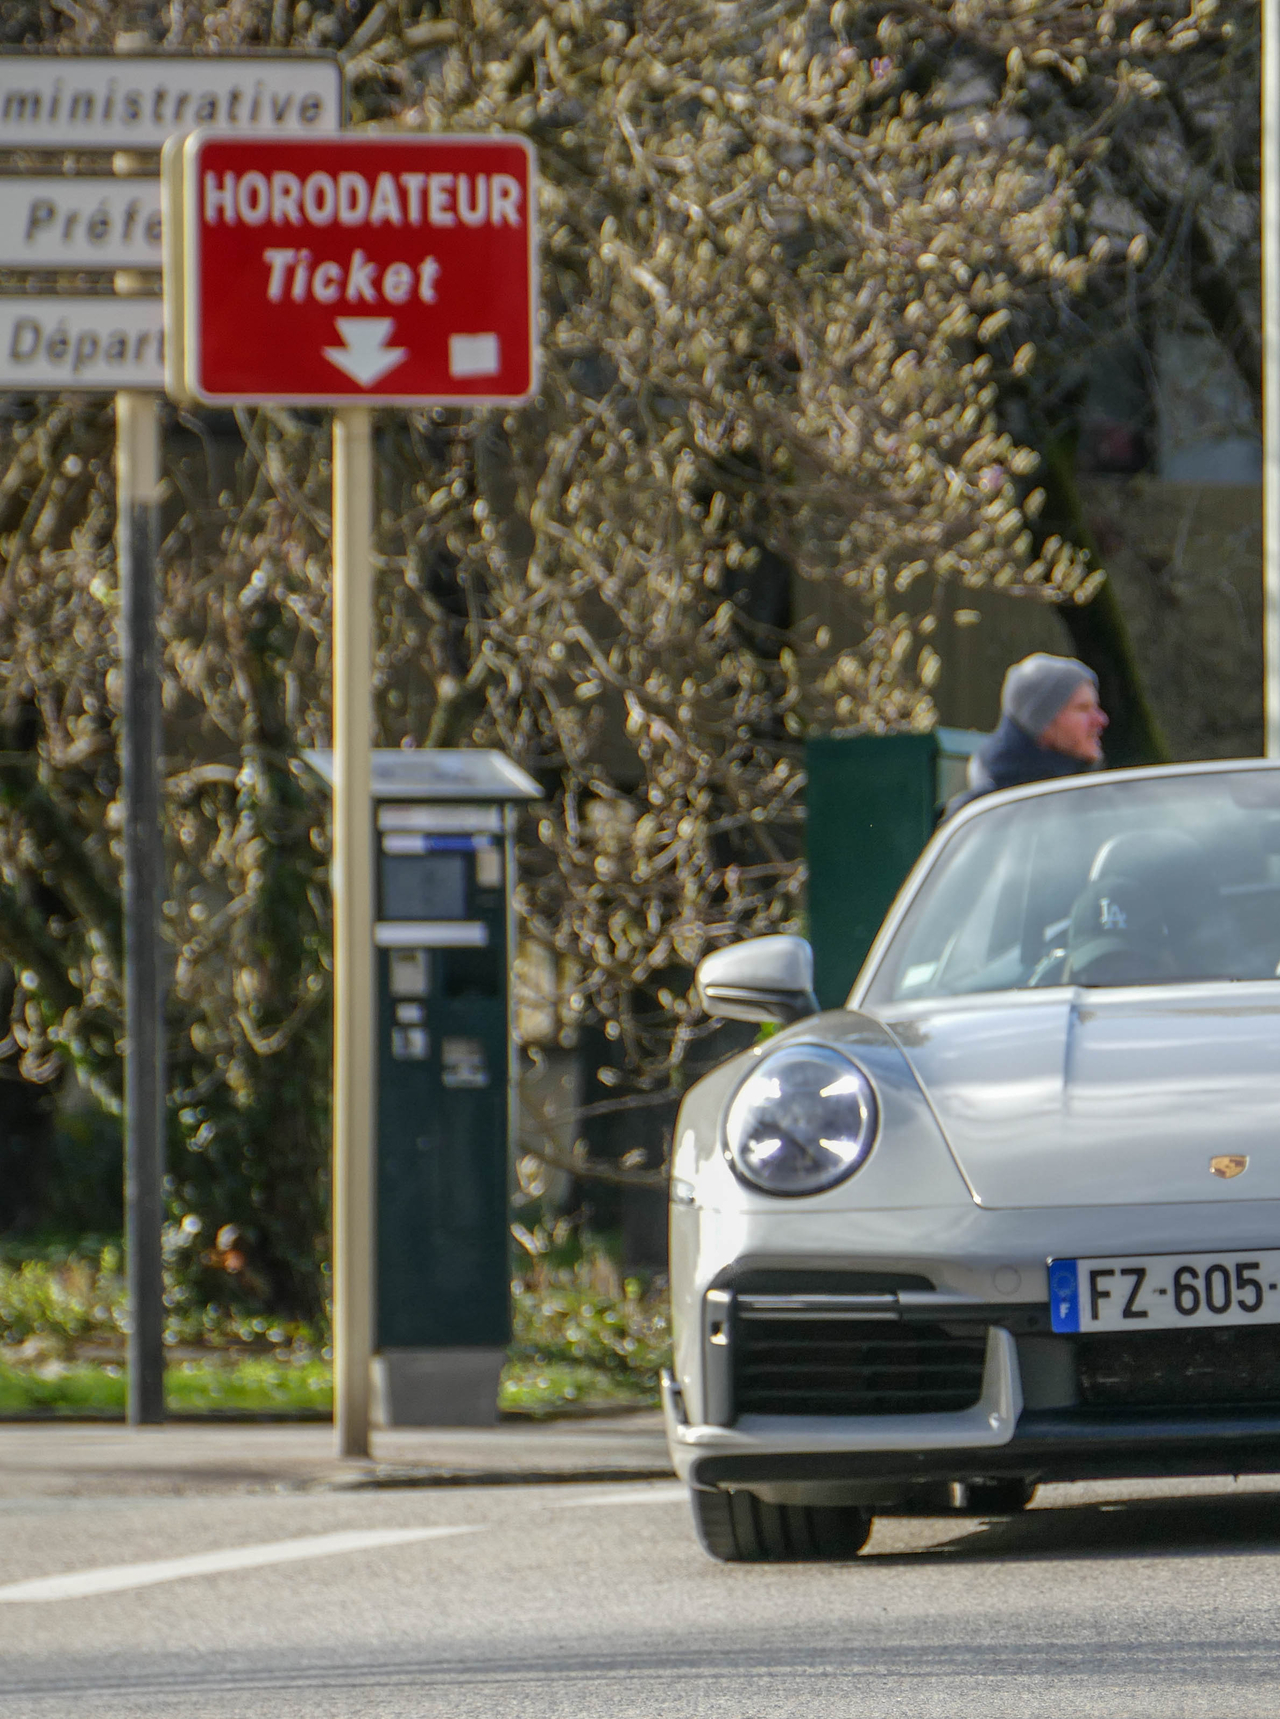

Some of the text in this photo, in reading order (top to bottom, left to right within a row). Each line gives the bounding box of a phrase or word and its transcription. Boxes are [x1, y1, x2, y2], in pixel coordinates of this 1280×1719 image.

[4, 76, 323, 125] ministrative
[203, 170, 522, 228] HORODATEUR
[263, 247, 441, 304] Ticket
[1099, 897, 1127, 929] LA
[1059, 1303, 1070, 1319] F
